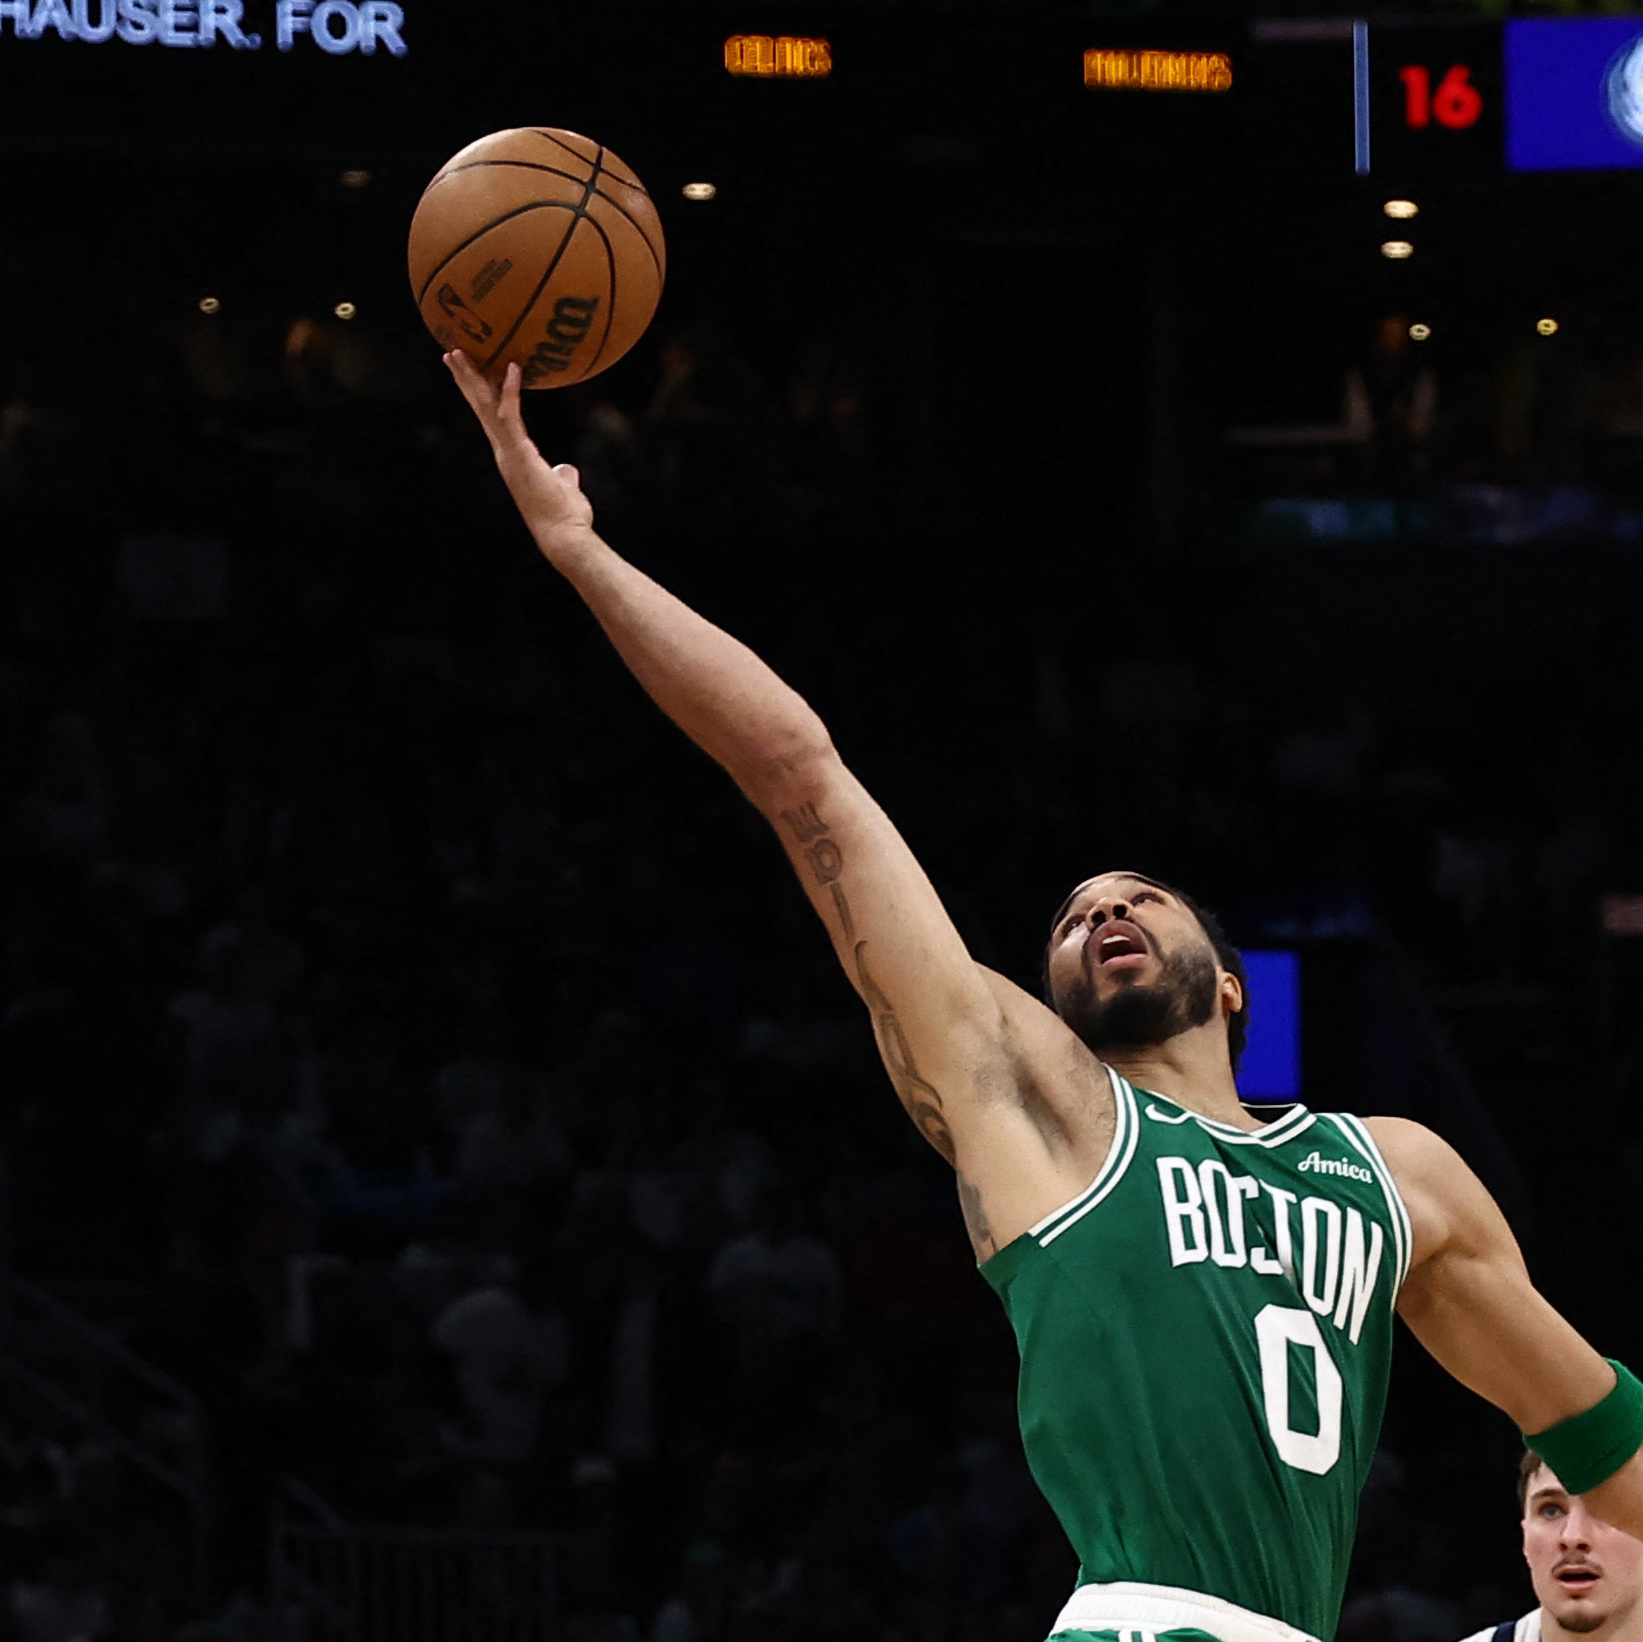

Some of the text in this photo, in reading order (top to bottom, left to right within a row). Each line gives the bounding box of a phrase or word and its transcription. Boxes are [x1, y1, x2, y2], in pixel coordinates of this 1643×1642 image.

[275, 0, 409, 58] FOR
[1399, 65, 1482, 129] 16
[1297, 1151, 1374, 1185] Amica
[1254, 1303, 1343, 1476] 0
